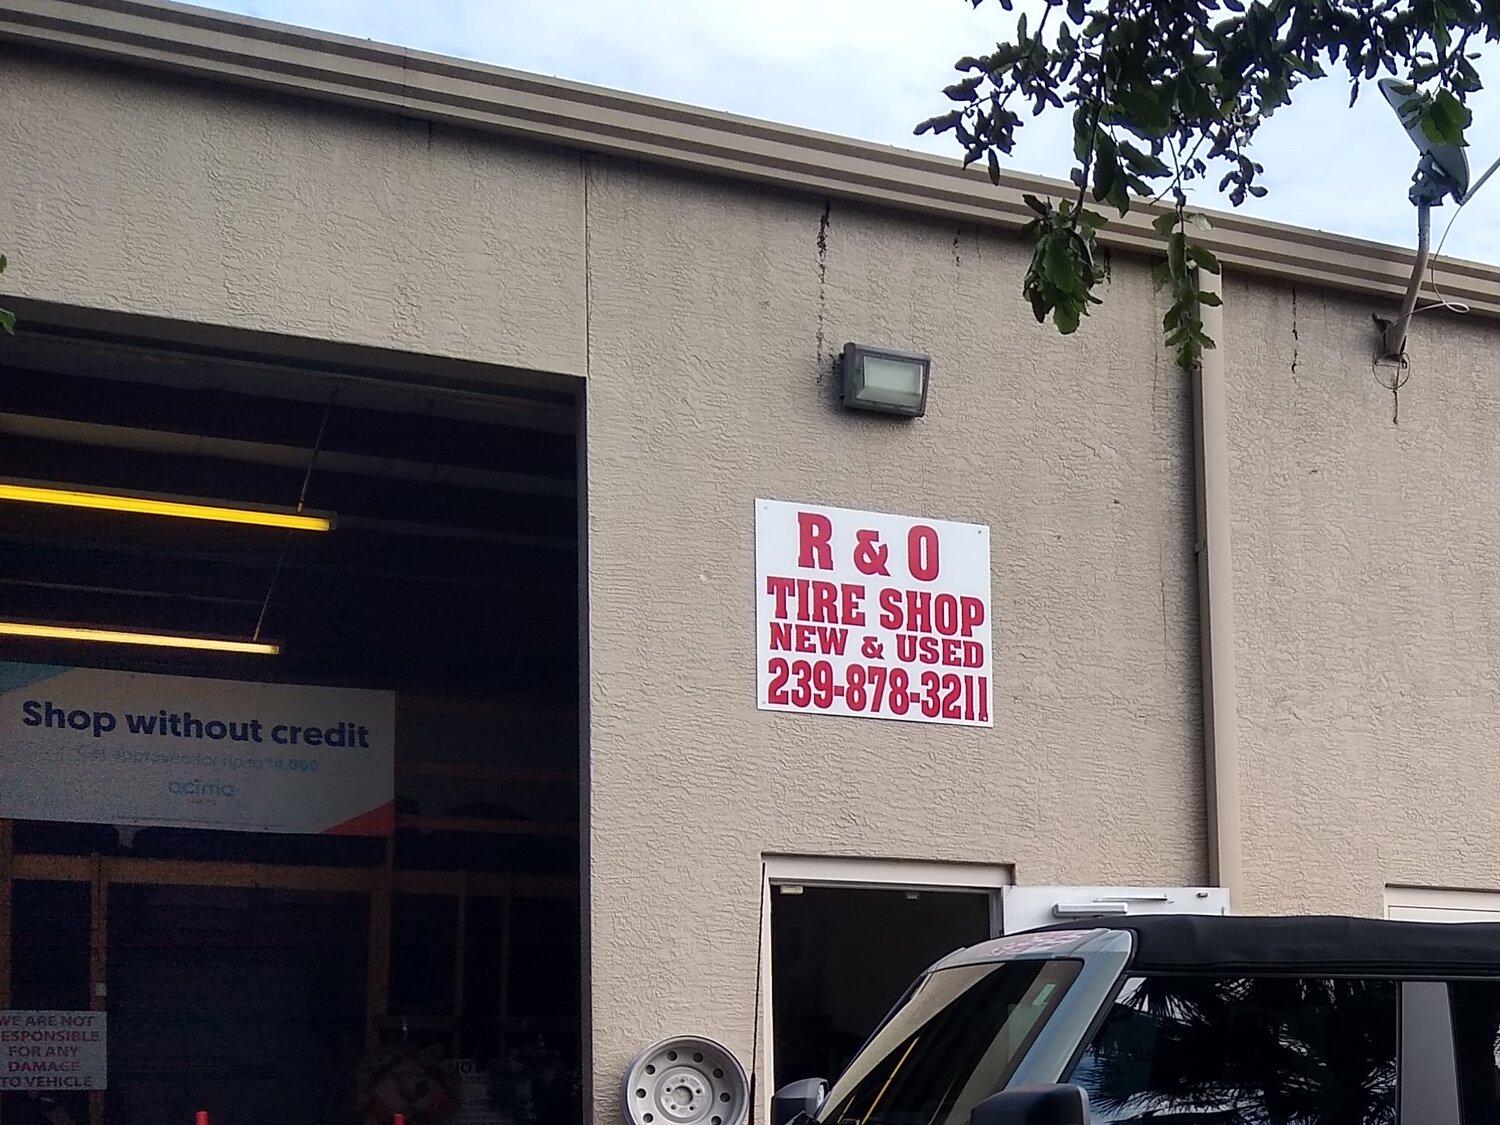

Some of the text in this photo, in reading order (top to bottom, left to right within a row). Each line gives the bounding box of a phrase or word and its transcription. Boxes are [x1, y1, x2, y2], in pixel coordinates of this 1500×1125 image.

[798, 511, 939, 581] R & O
[766, 575, 985, 637] TIRE SHOP
[769, 622, 984, 669] NEW & USED
[768, 657, 989, 722] 239-878-3211
[21, 700, 371, 749] Shop without credit
[167, 779, 235, 797] acima
[25, 1015, 57, 1026] ARE
[60, 1015, 96, 1027] NOT
[0, 1030, 100, 1042] ESPONSIBLE
[8, 1046, 79, 1057] FOR ANY
[8, 1061, 80, 1072] DAMAGE
[27, 1076, 93, 1087] VEHICLE
